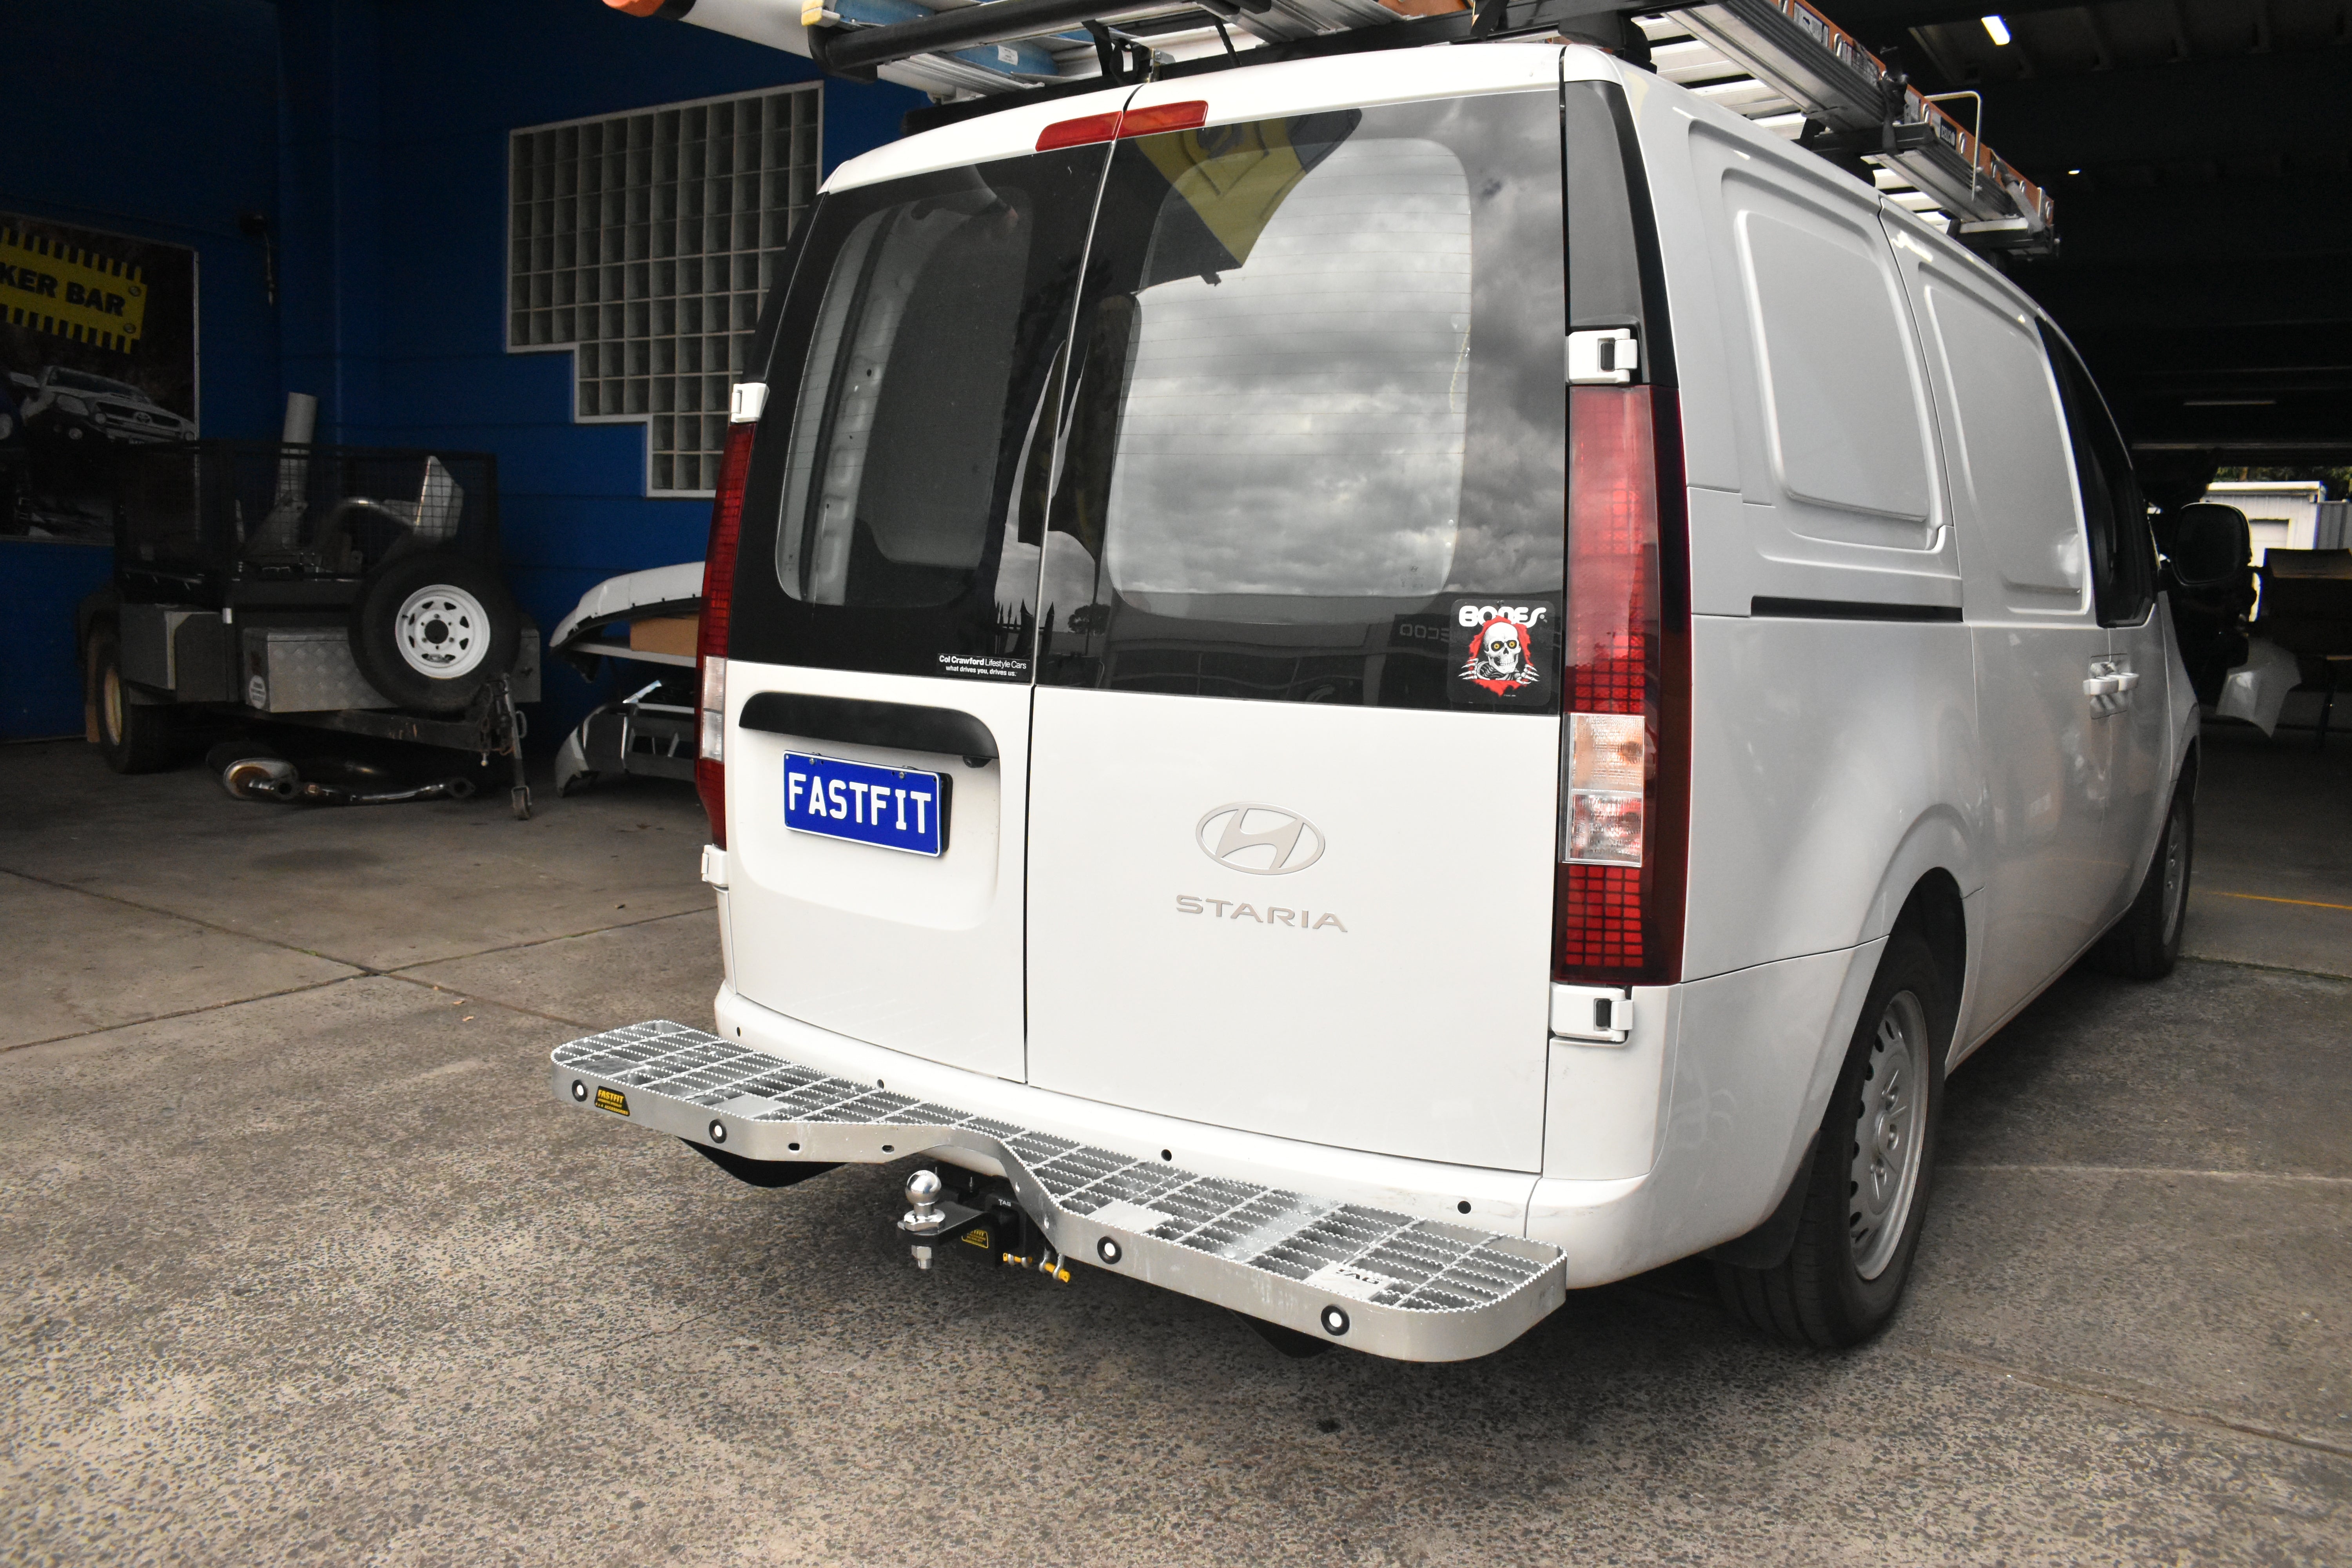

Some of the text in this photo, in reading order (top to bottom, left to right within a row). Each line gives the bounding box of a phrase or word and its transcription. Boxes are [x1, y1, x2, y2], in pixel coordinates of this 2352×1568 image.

[66, 281, 125, 317] BAR
[1459, 605, 1546, 628] BONES
[951, 656, 984, 666] Crawford
[985, 659, 1010, 669] Lifestyle
[1011, 661, 1027, 669] Cars
[789, 772, 931, 833] FASTFIT
[1176, 894, 1348, 933] STARIA
[598, 1089, 624, 1103] FASTFIT
[998, 1199, 1011, 1207] TAG
[1336, 1267, 1383, 1284] TAG
